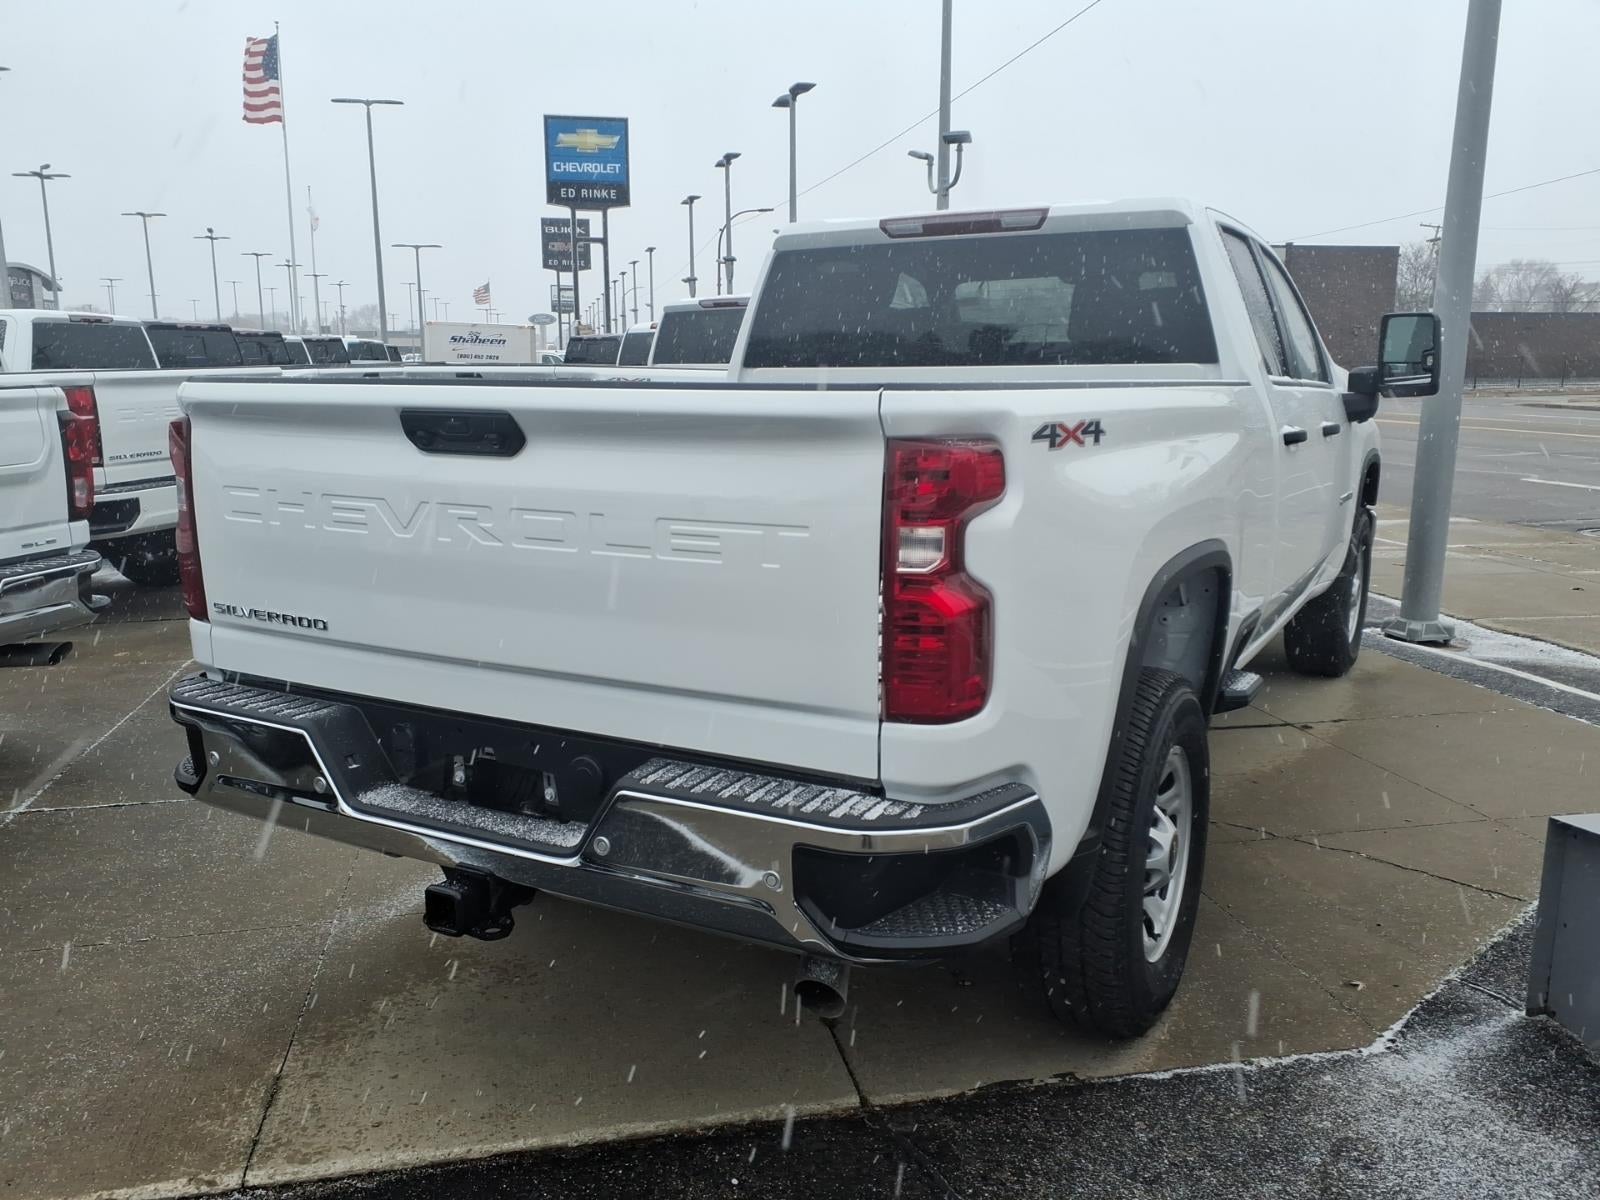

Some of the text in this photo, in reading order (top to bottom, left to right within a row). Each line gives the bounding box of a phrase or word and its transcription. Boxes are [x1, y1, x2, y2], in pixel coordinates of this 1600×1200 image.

[553, 161, 621, 174] CHEVROLET
[560, 187, 617, 199] ED RINKE
[449, 335, 507, 345] Shaheen
[1031, 418, 1106, 451] 4X4
[108, 450, 163, 461] SILVERADO
[222, 485, 810, 568] CHEVROLET
[213, 602, 329, 631] SILVERADO
